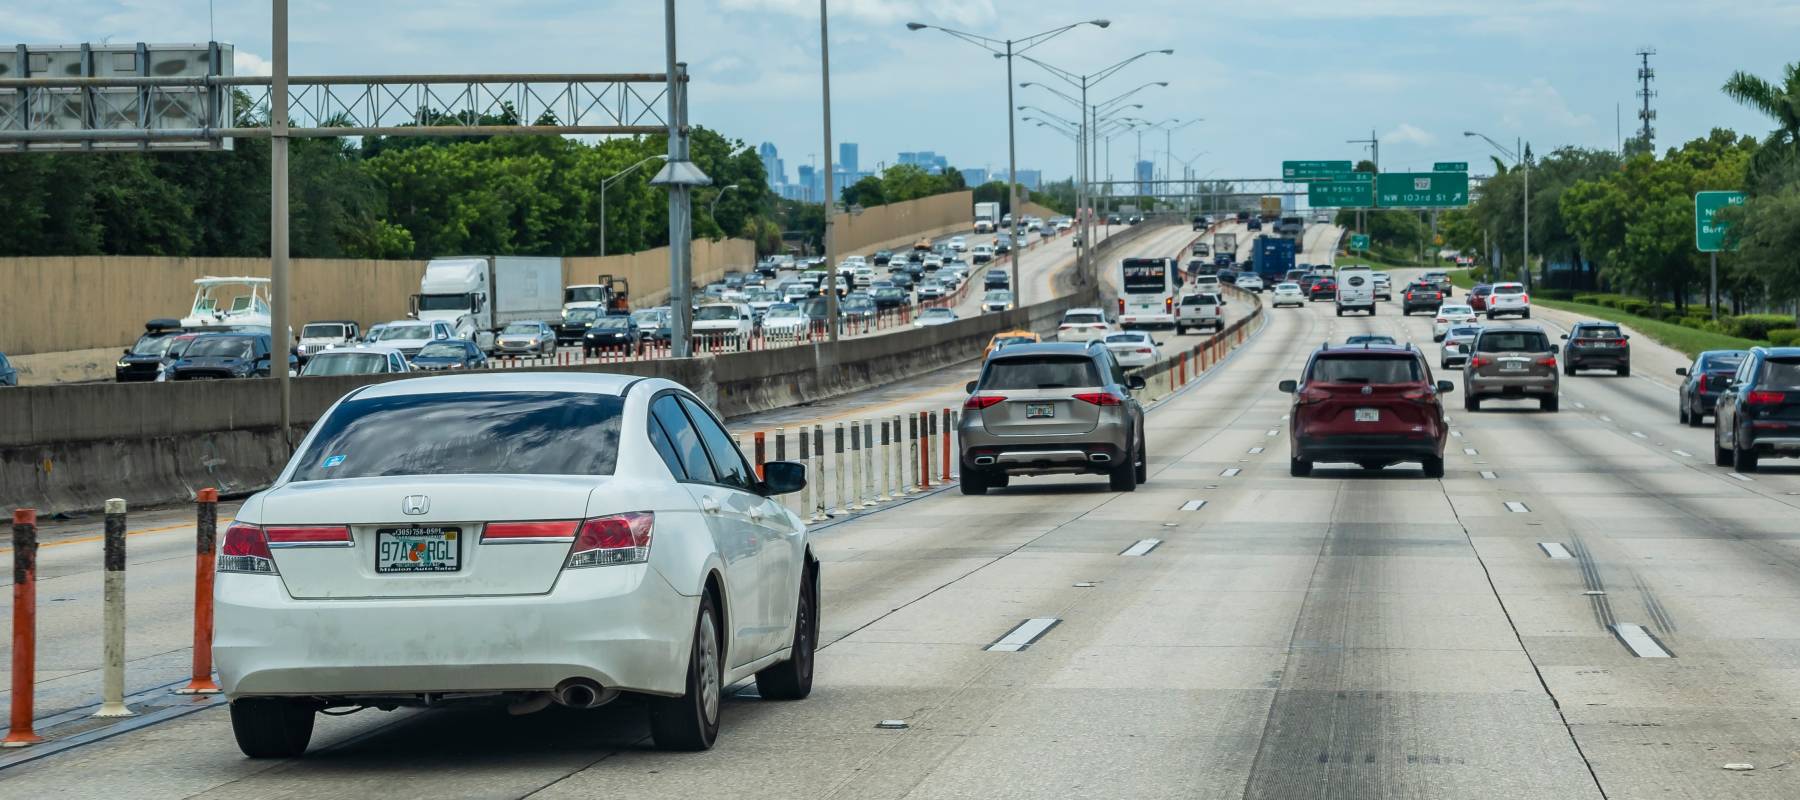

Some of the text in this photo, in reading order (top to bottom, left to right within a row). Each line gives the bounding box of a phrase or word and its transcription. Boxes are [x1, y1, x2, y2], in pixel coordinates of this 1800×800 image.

[1383, 194, 1446, 202] NW 103rd St
[381, 540, 455, 562] 97A RGL
